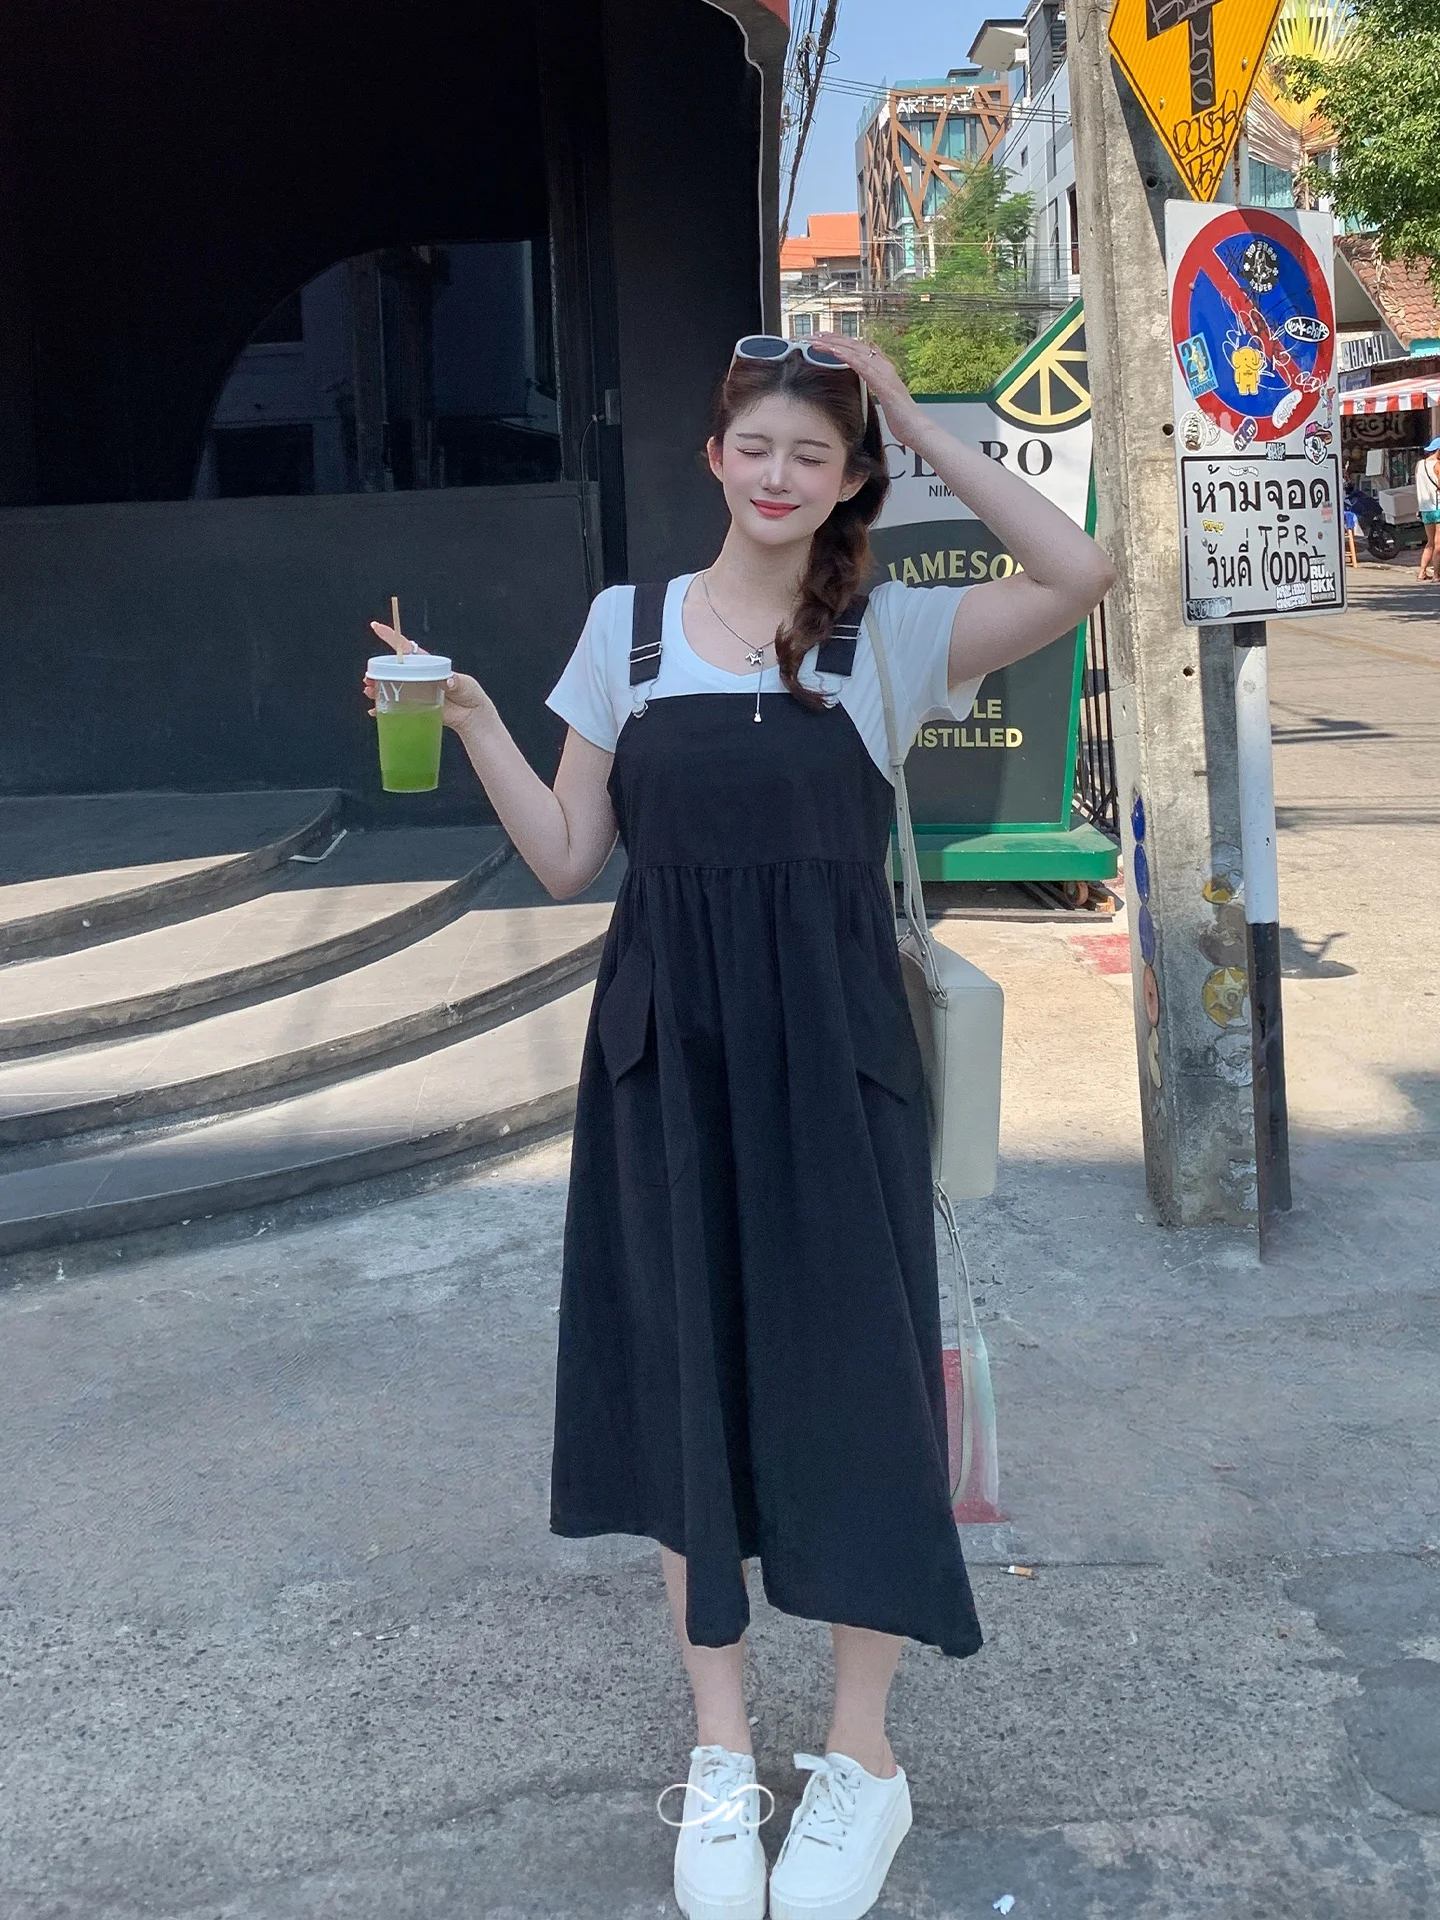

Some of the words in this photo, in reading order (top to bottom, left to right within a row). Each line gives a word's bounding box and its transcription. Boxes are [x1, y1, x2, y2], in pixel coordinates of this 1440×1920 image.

[1349, 334, 1385, 368] HACHI
[1192, 463, 1330, 514] ห้ามจอด
[1207, 527, 1252, 588] วันคี่
[1261, 545, 1318, 591] (ODD
[1310, 577, 1336, 594] BKK
[917, 727, 1023, 748] ISTILLED
